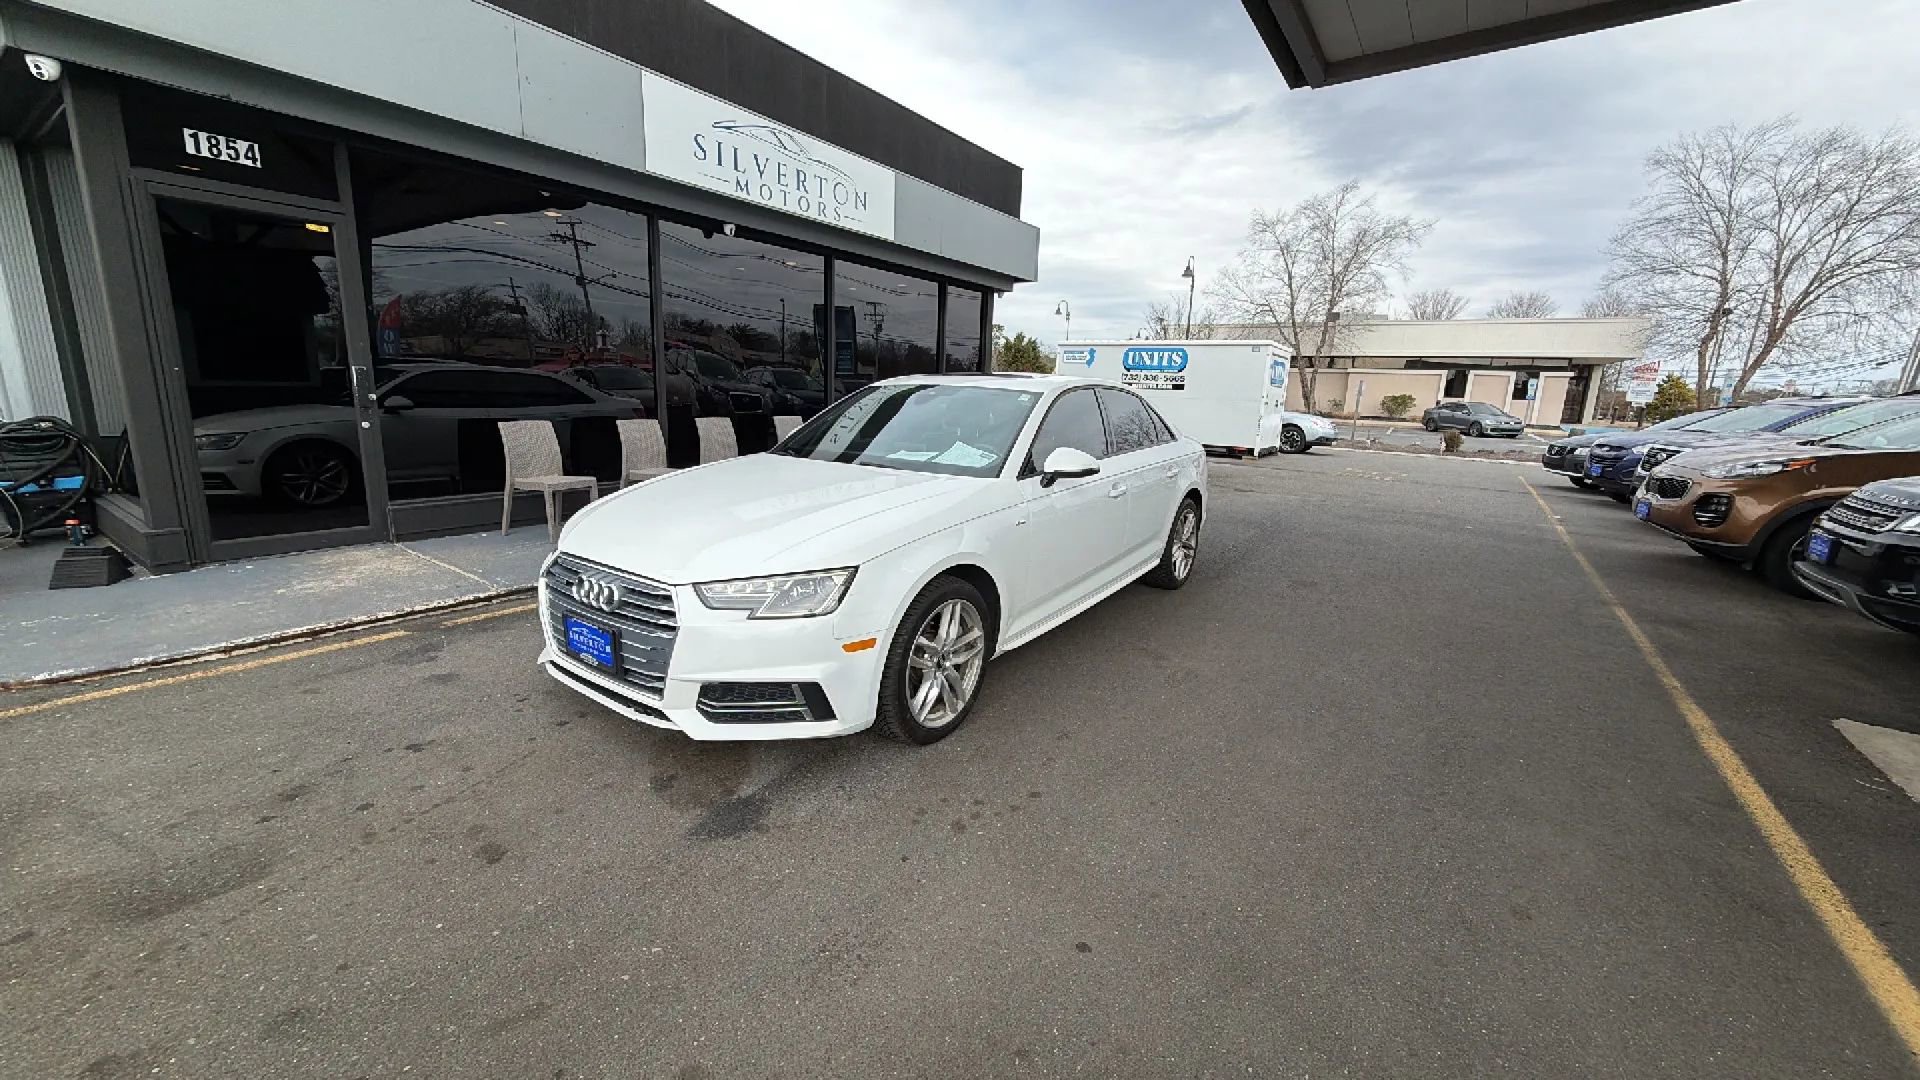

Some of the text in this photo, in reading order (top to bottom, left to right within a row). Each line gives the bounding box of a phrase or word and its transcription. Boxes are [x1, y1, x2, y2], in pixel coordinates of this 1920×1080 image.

[187, 130, 260, 167] 1854
[693, 133, 868, 211] SILVERTON
[734, 175, 841, 222] MOTORS
[1127, 351, 1183, 366] UNITS
